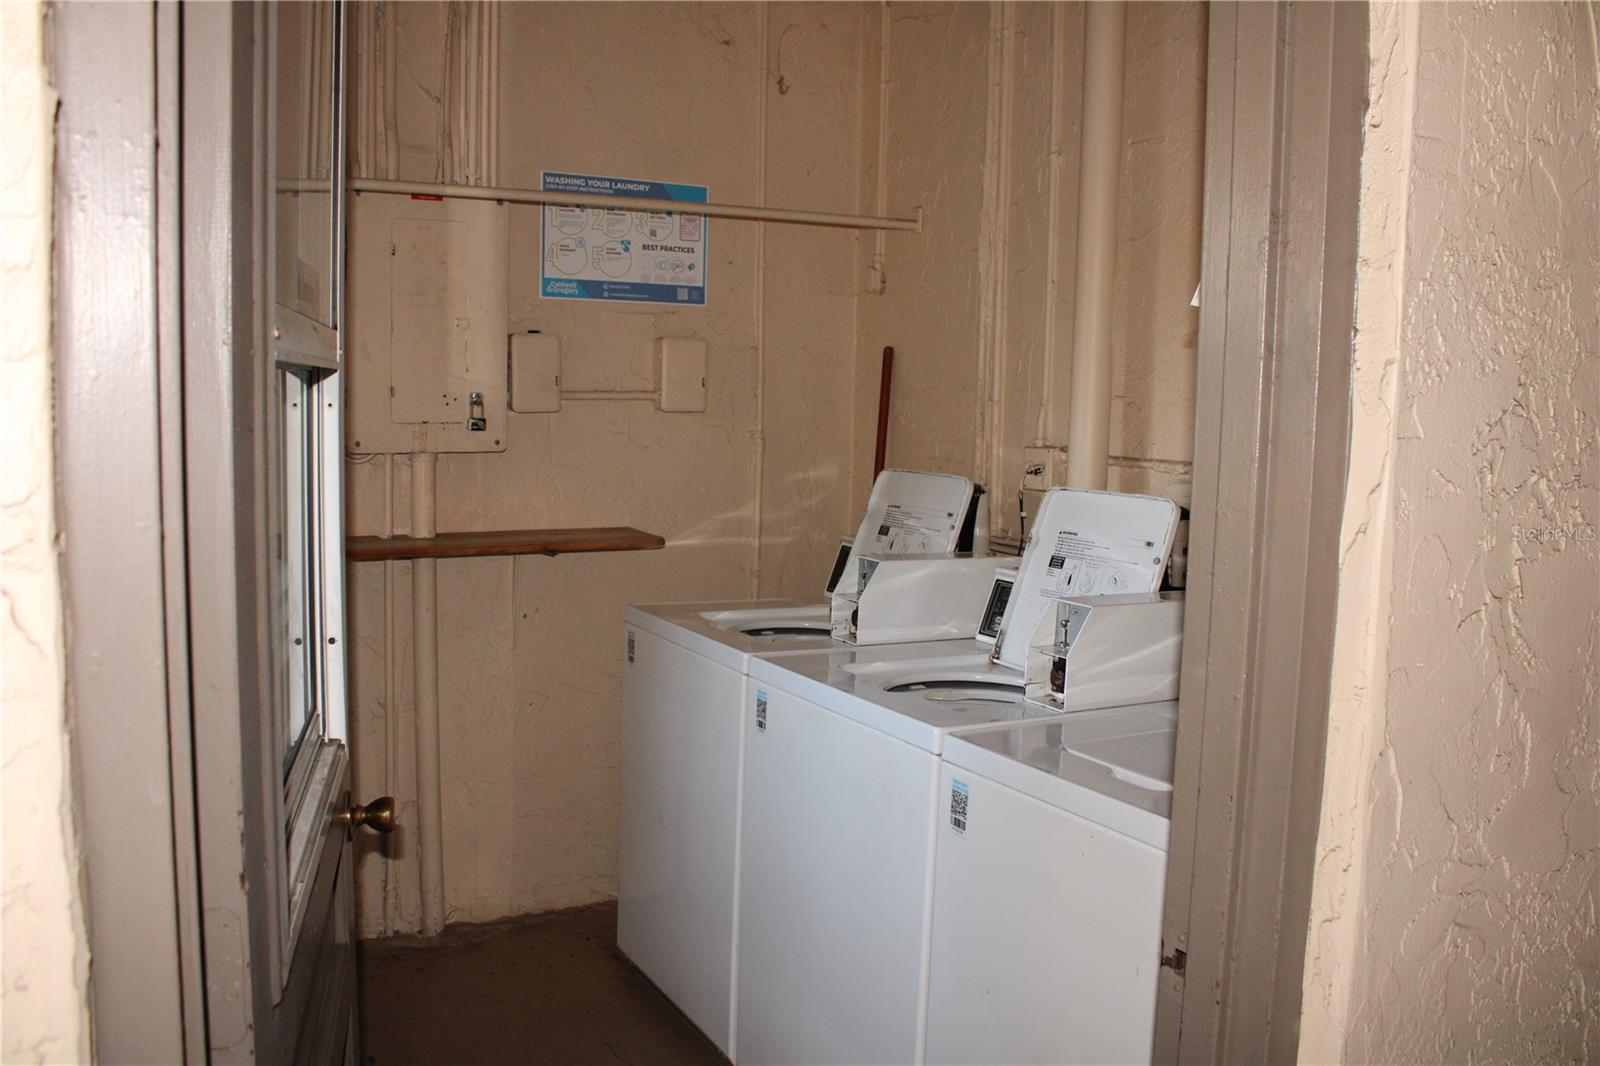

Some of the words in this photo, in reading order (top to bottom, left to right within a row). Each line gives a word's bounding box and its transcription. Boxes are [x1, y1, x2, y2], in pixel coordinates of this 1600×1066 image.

[545, 176, 586, 186] WASHING
[587, 179, 610, 188] YOUR
[612, 182, 650, 192] LAUNDRY
[642, 243, 658, 251] BEST
[660, 245, 695, 254] PRACTICES
